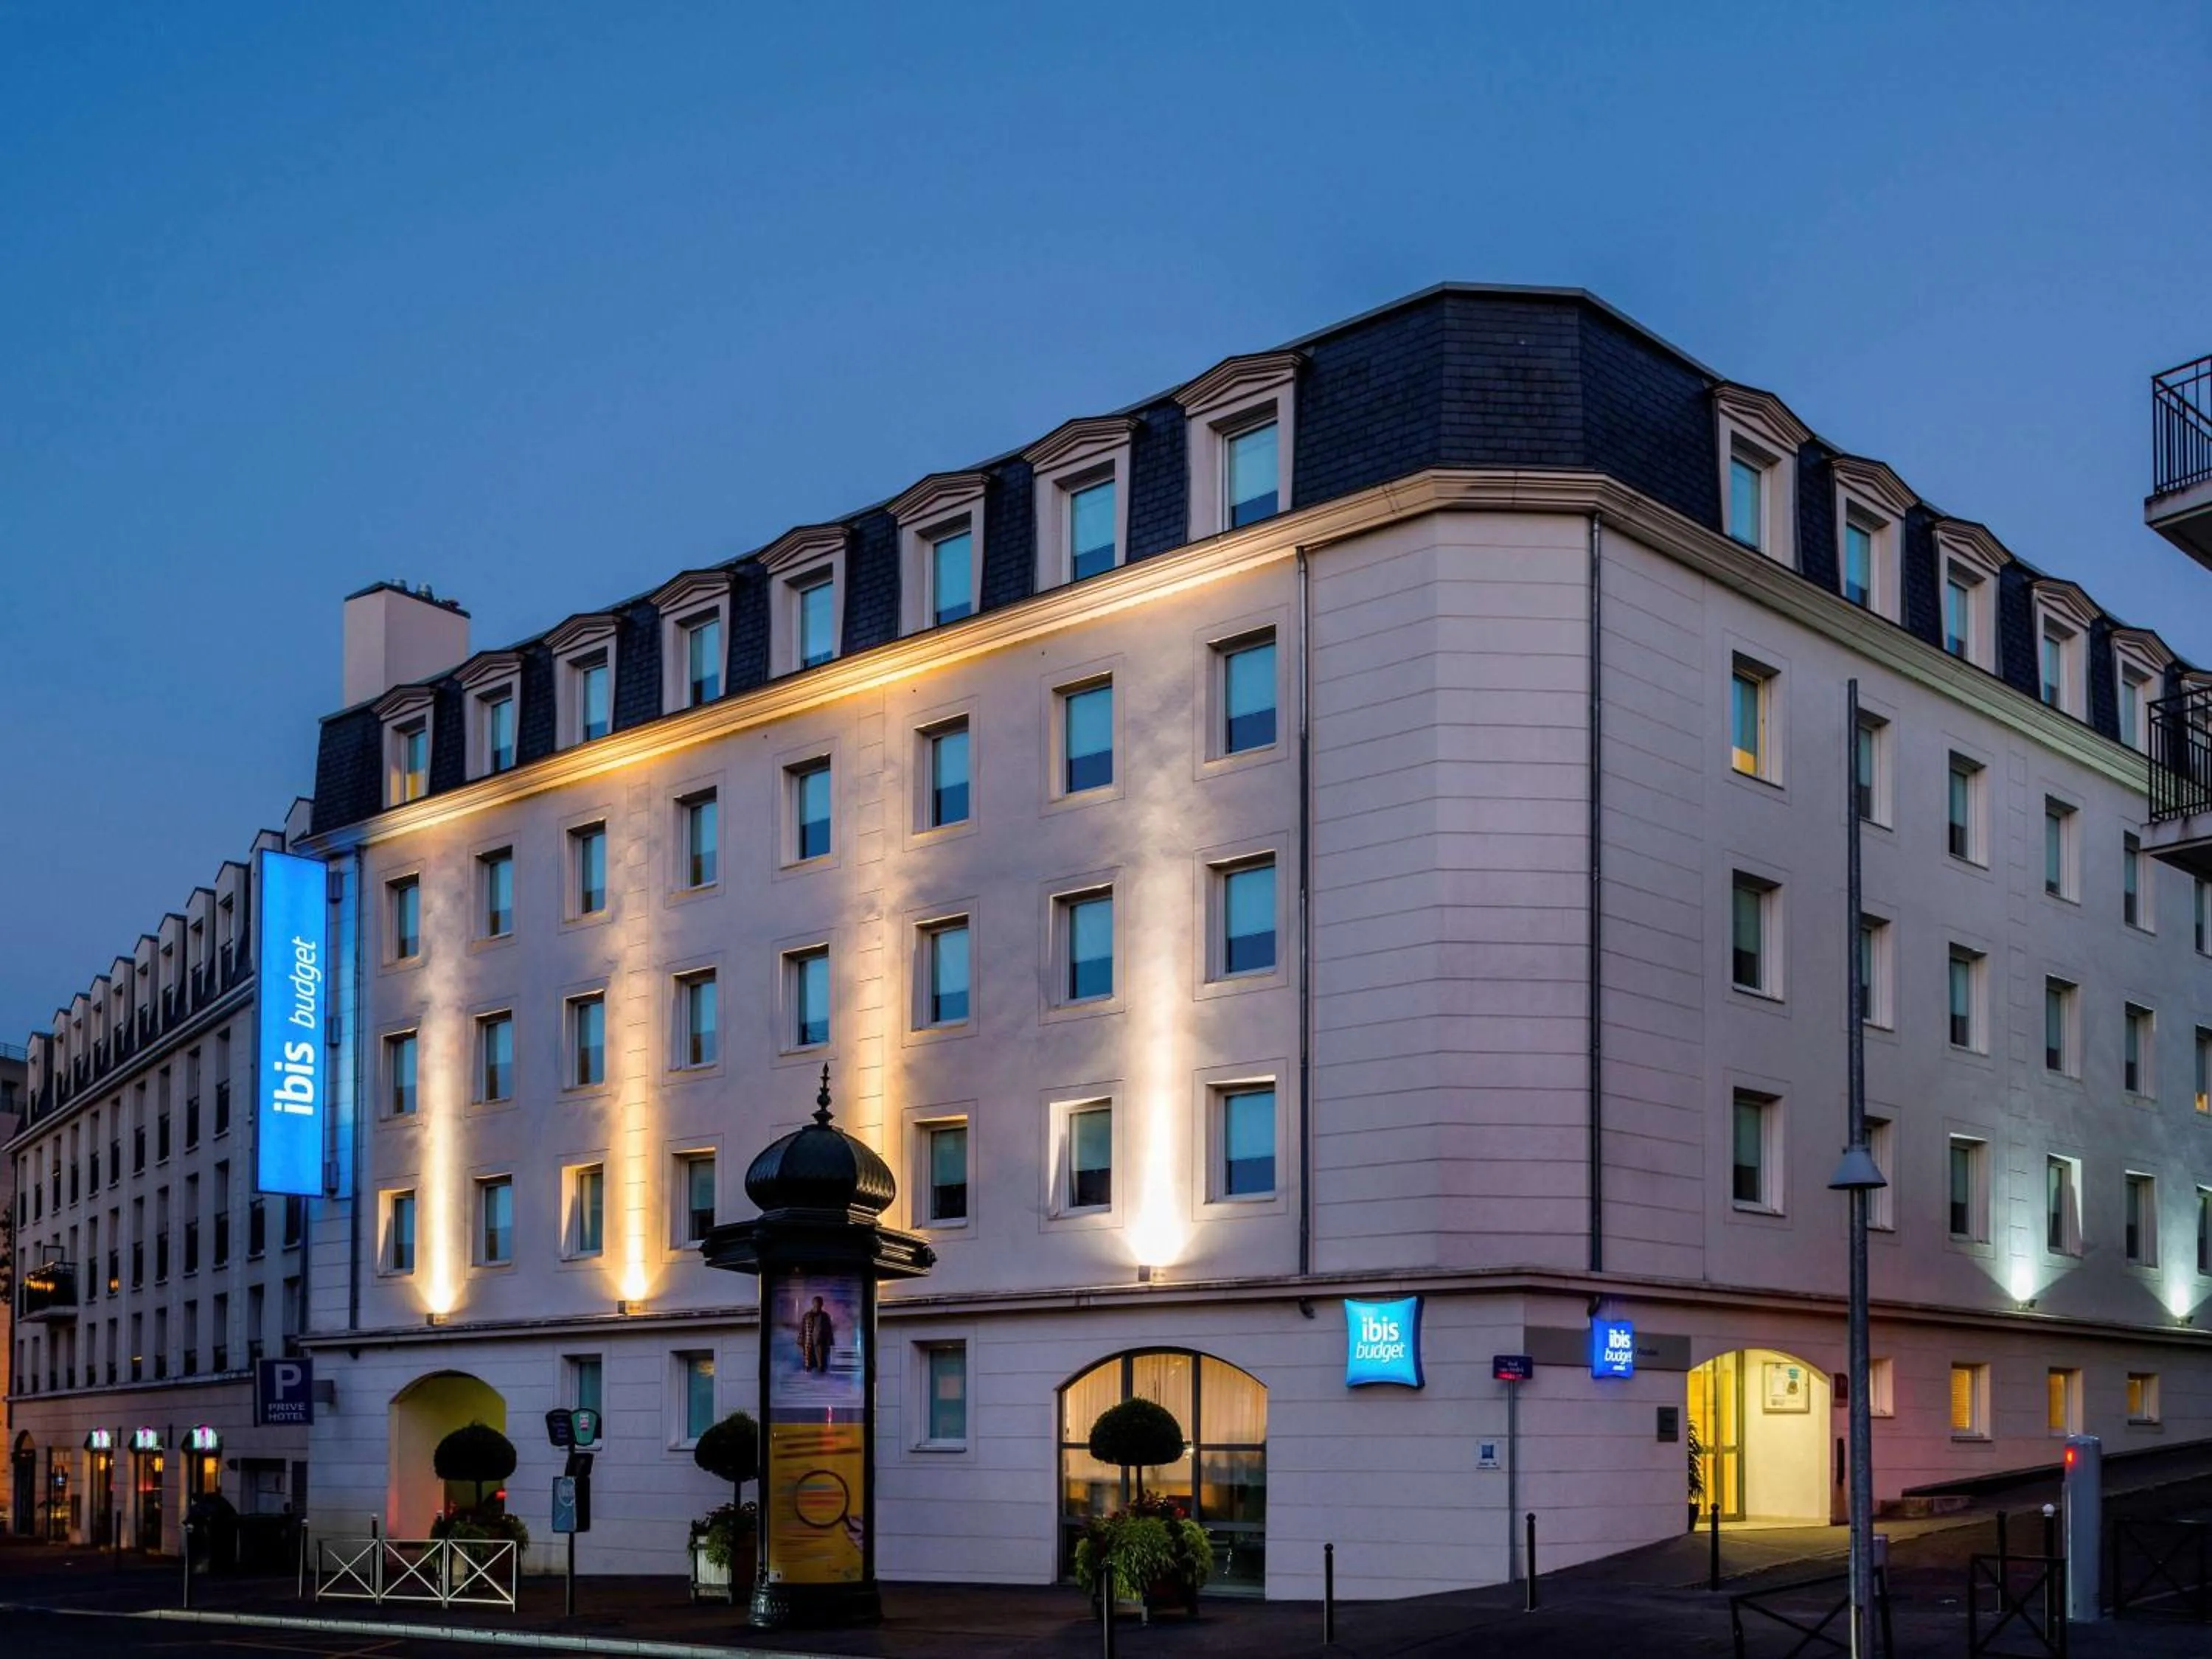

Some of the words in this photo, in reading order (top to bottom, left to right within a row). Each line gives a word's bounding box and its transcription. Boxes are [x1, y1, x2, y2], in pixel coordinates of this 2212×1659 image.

[288, 936, 321, 1029] budget
[274, 1041, 315, 1116] ibis
[1362, 1316, 1400, 1342] ibis
[1609, 1329, 1631, 1349] ibis
[1357, 1342, 1405, 1363] budget
[275, 1364, 302, 1399] P
